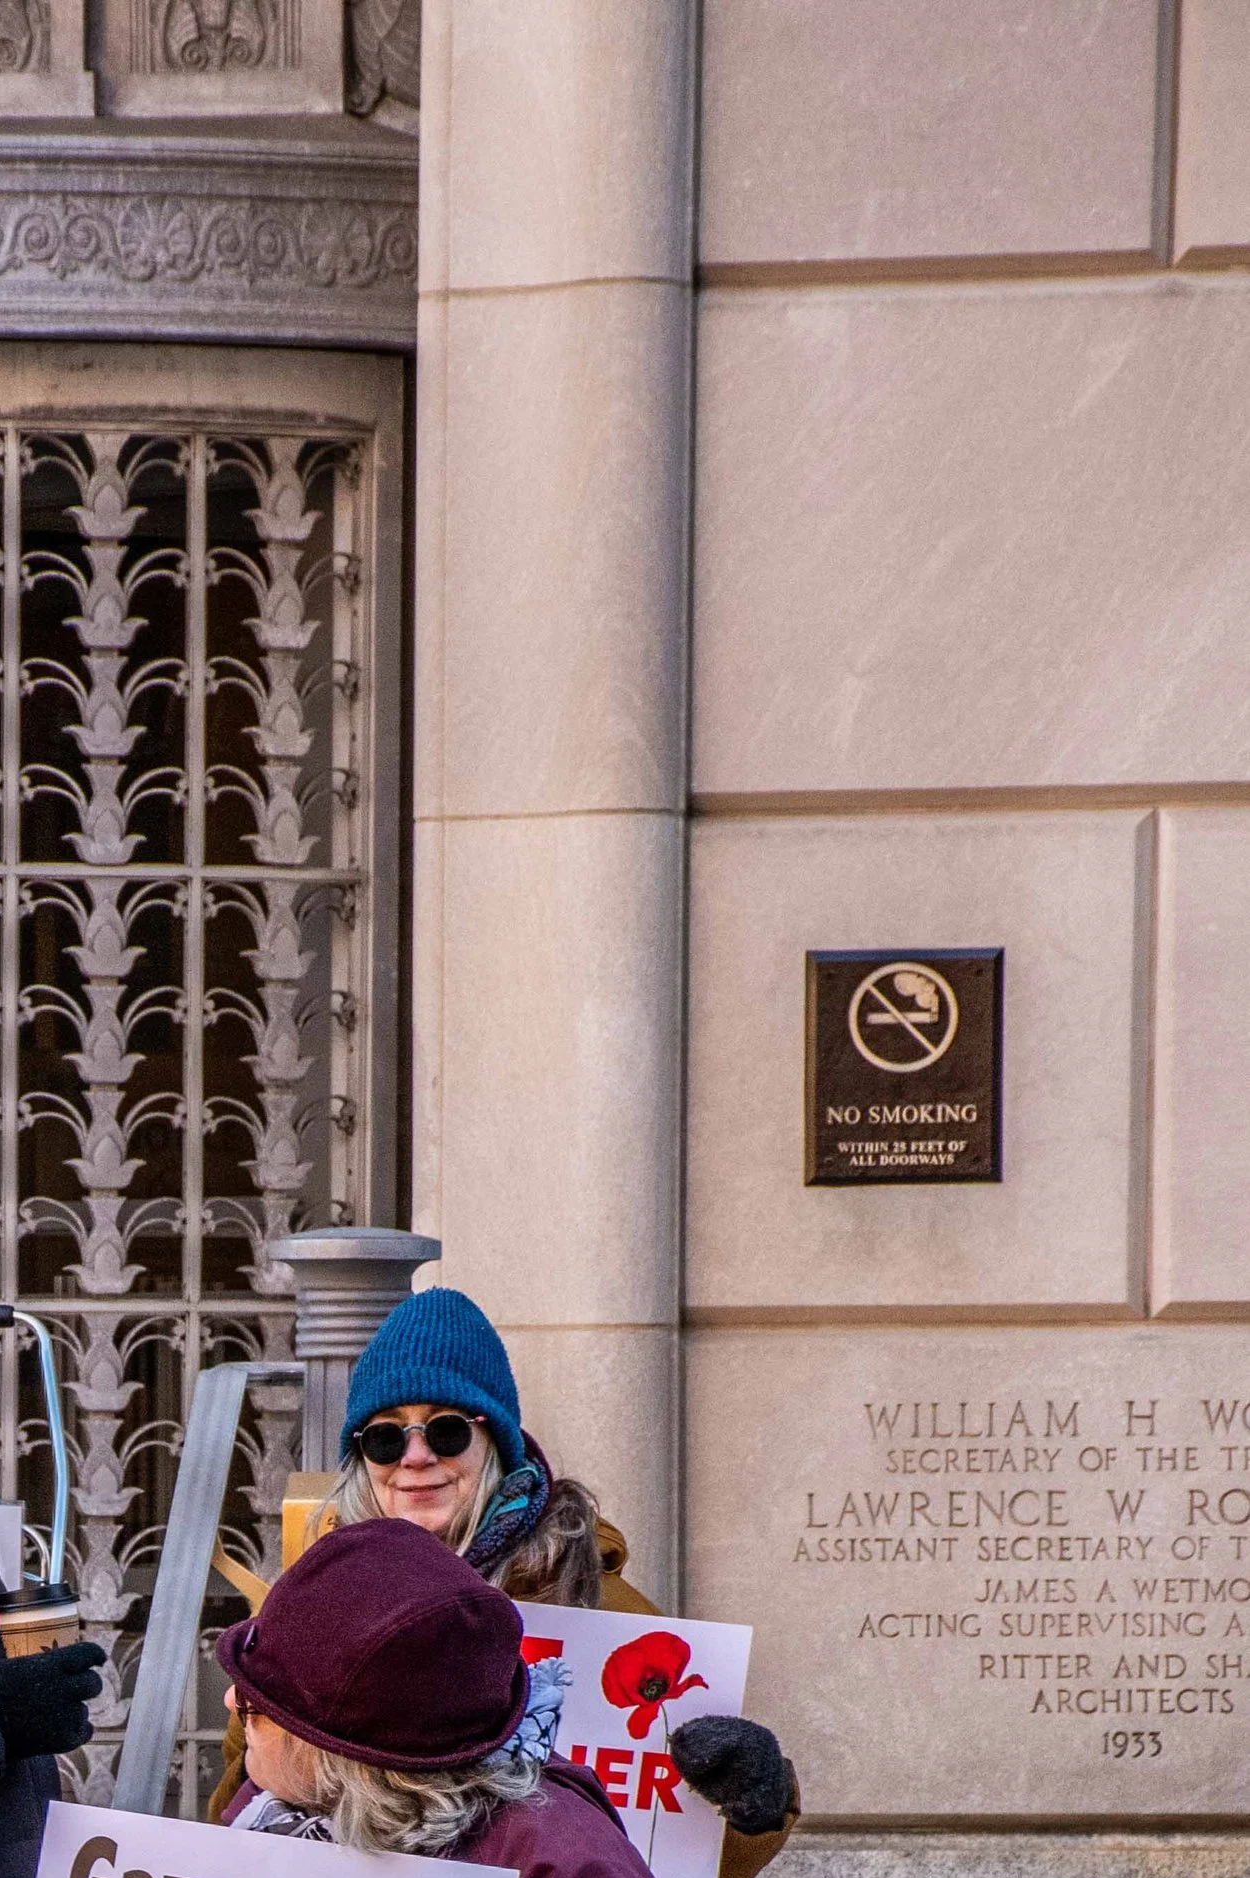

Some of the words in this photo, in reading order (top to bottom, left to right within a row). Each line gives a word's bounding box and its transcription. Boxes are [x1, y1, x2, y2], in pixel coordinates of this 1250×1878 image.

[827, 1106, 861, 1124] NO
[868, 1104, 977, 1124] SMOKING
[837, 1142, 889, 1153] WITHIN
[893, 1142, 907, 1153] 25
[910, 1141, 945, 1152] FEET
[948, 1141, 968, 1152] OF
[850, 1155, 876, 1166] ALL
[880, 1154, 955, 1166] DOORWAYS
[863, 1400, 1080, 1439] WILLIAM
[1125, 1400, 1159, 1438] H
[1203, 1399, 1250, 1435] W
[885, 1447, 1062, 1475] SECRETARY
[1078, 1446, 1118, 1472] OF
[1136, 1446, 1200, 1472] THE
[806, 1490, 1069, 1528] LAWRENCE
[1106, 1490, 1146, 1526] W
[792, 1537, 959, 1563] ASSISTANT
[977, 1536, 1154, 1562] SECRETARY
[1171, 1535, 1211, 1561] OF
[974, 1578, 1079, 1603] JAMES
[1095, 1578, 1118, 1603] A
[1133, 1578, 1250, 1602] WETMO
[857, 1613, 983, 1639] ACTING
[999, 1612, 1207, 1638] SUPERVISING
[979, 1654, 1092, 1680] RITTER
[1113, 1654, 1187, 1680] AND
[1205, 1653, 1250, 1679] SH
[1030, 1688, 1235, 1714] ARCHITECTS
[1102, 1731, 1163, 1758] 1933
